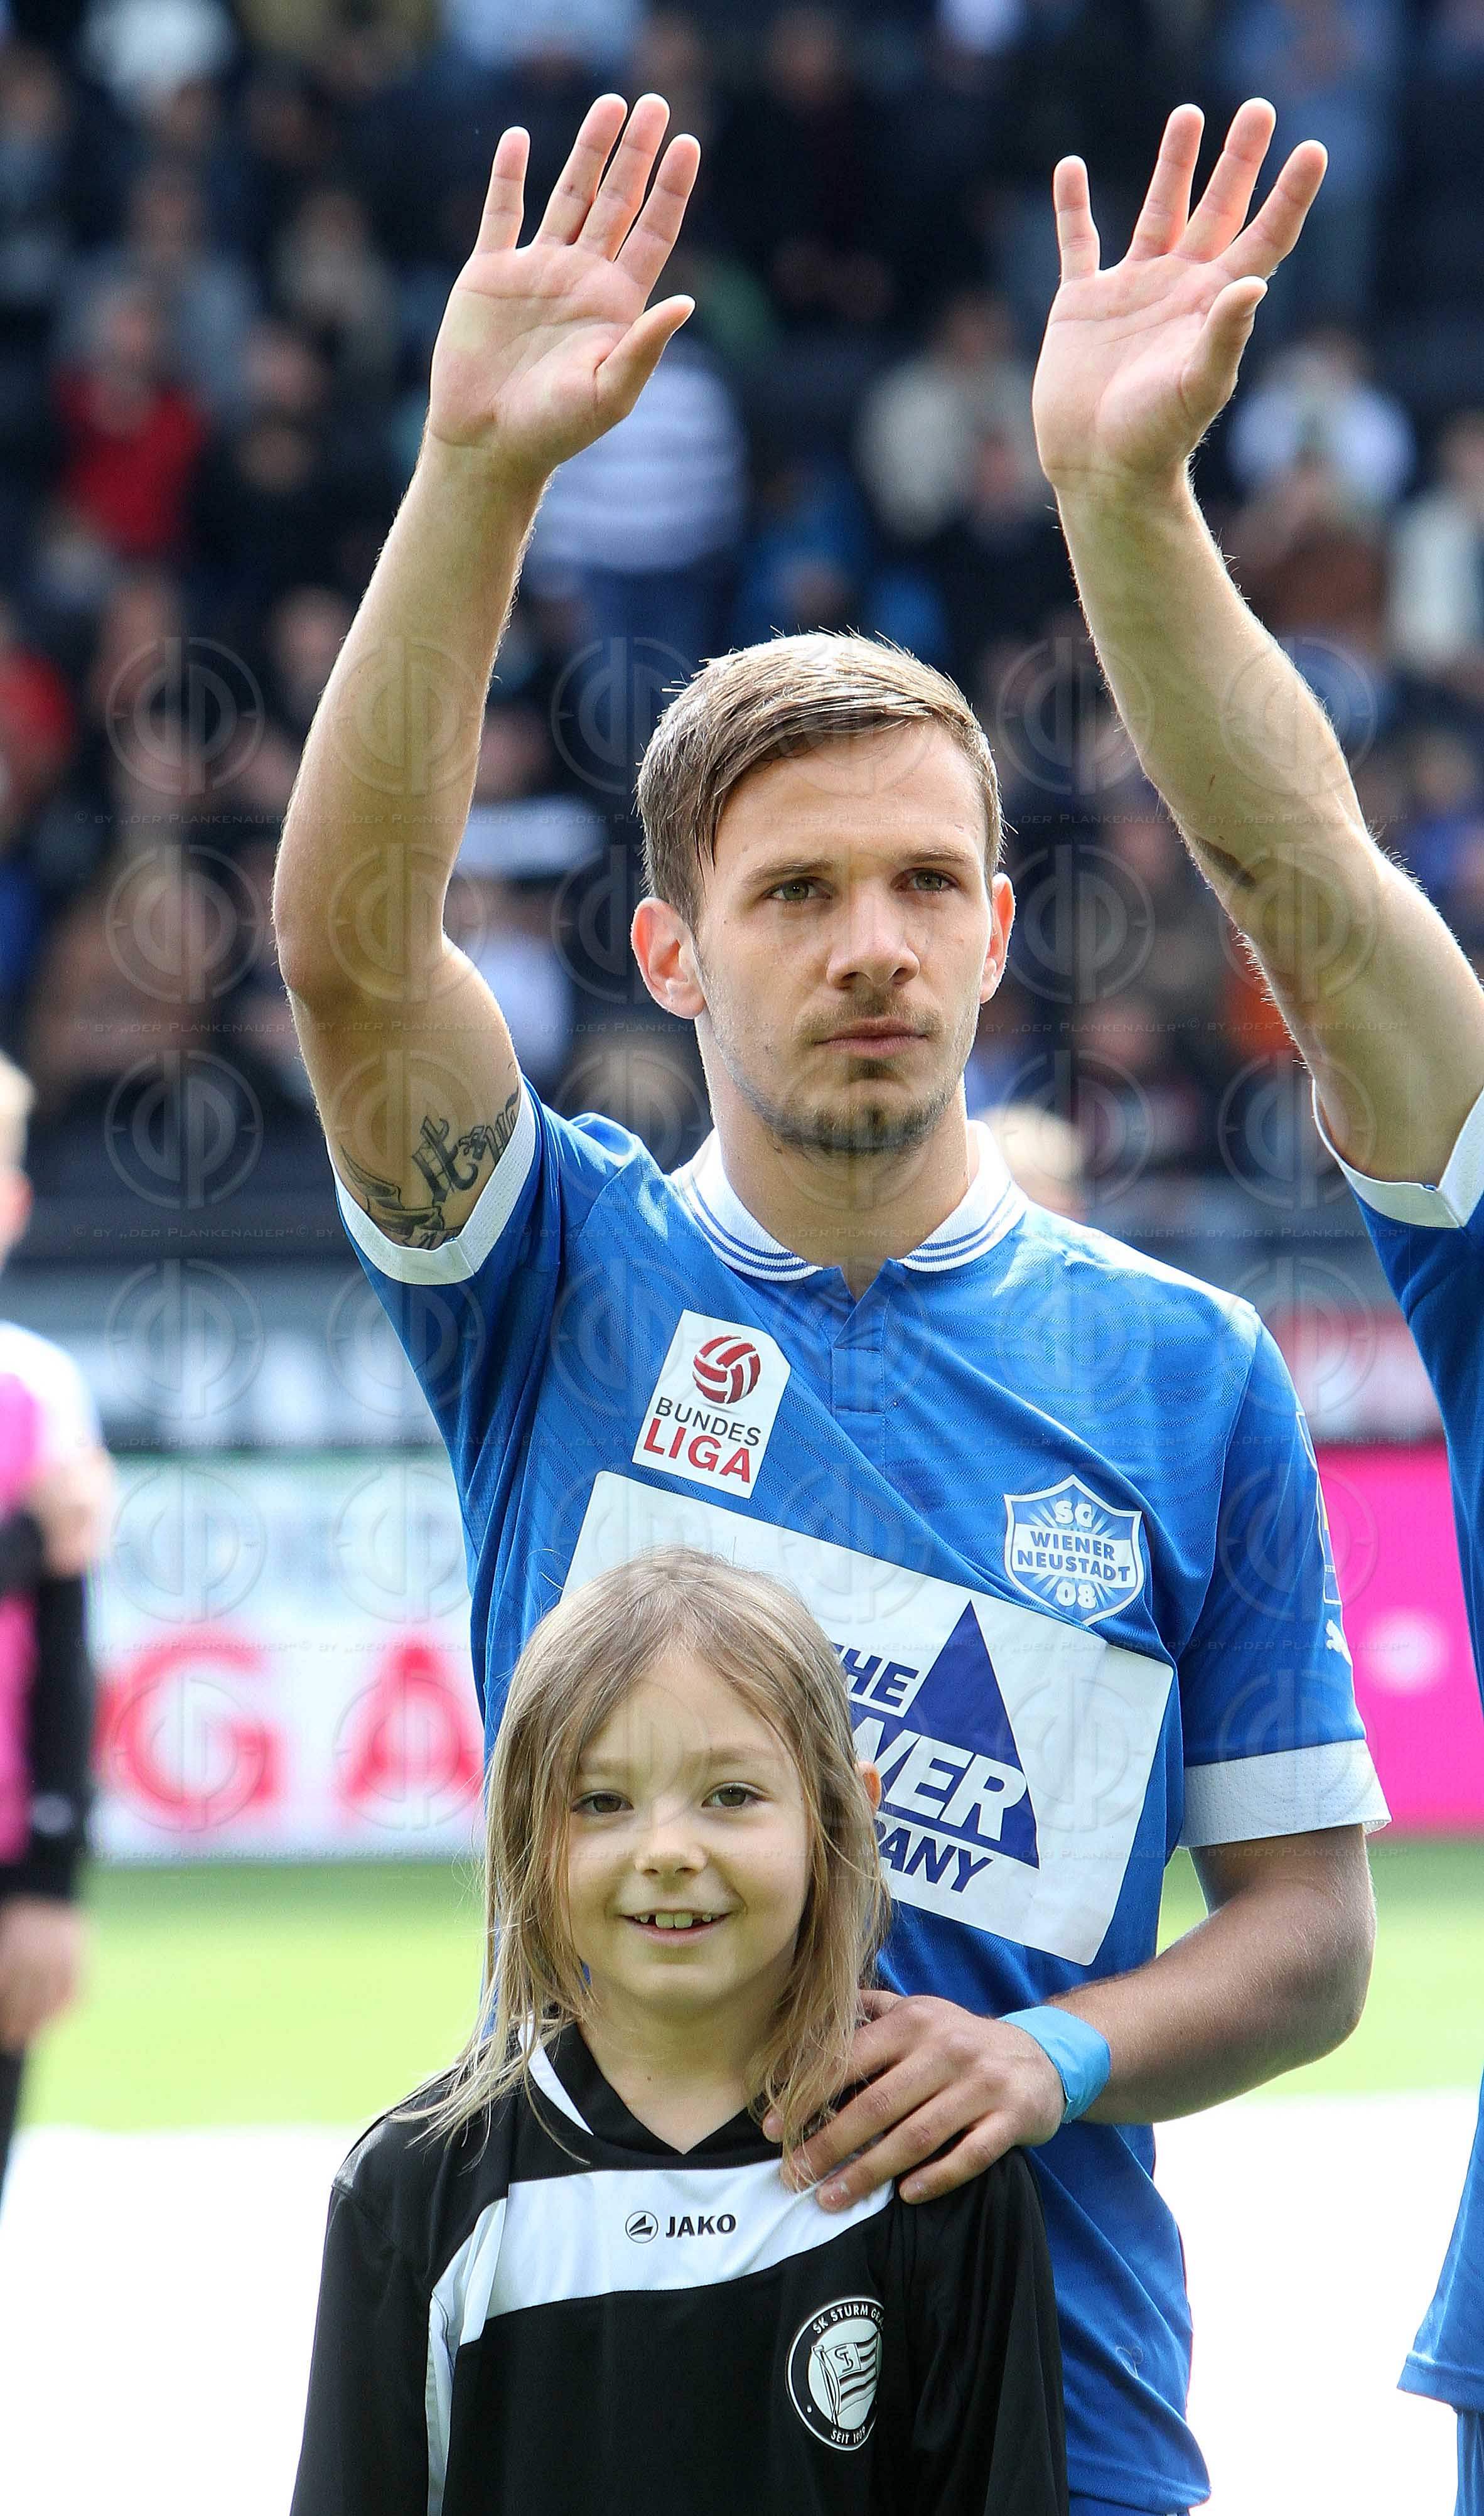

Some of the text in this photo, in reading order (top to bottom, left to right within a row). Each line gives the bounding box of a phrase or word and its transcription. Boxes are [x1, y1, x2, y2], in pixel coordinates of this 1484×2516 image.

[655, 1397, 761, 1446] BUNDES
[643, 1417, 751, 1483] LIGA
[1030, 1530, 1116, 1561] WIENER
[1017, 1549, 1131, 1582] NEUSTADT
[1057, 1581, 1097, 1610] 08
[665, 2213, 736, 2239] JAKO
[812, 2316, 829, 2334] SK
[830, 2304, 868, 2321] STURM
[831, 2429, 850, 2444] SEIT
